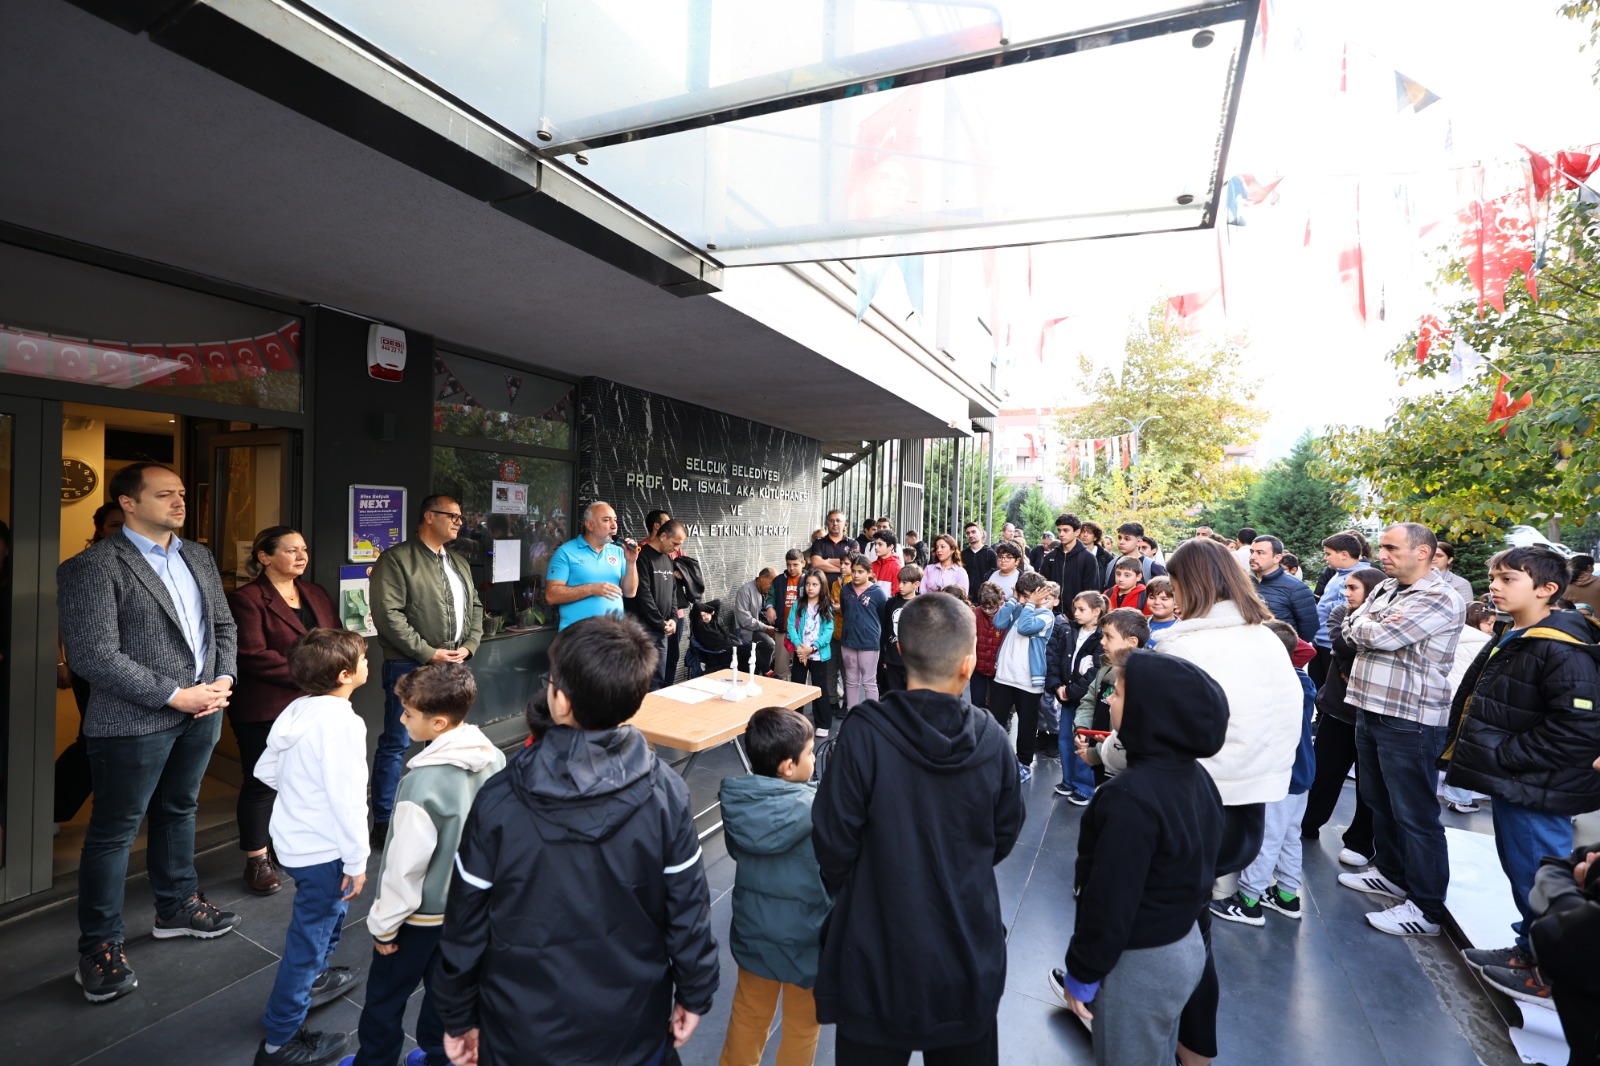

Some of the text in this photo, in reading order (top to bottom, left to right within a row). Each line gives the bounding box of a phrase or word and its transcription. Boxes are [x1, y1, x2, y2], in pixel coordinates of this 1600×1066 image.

[686, 457, 780, 482] SELÇUK BELEDİYESİ
[627, 473, 665, 490] PROF.
[672, 478, 692, 492] DR.
[736, 485, 756, 498] AKA
[359, 500, 391, 509] NEXT
[730, 504, 743, 516] VE
